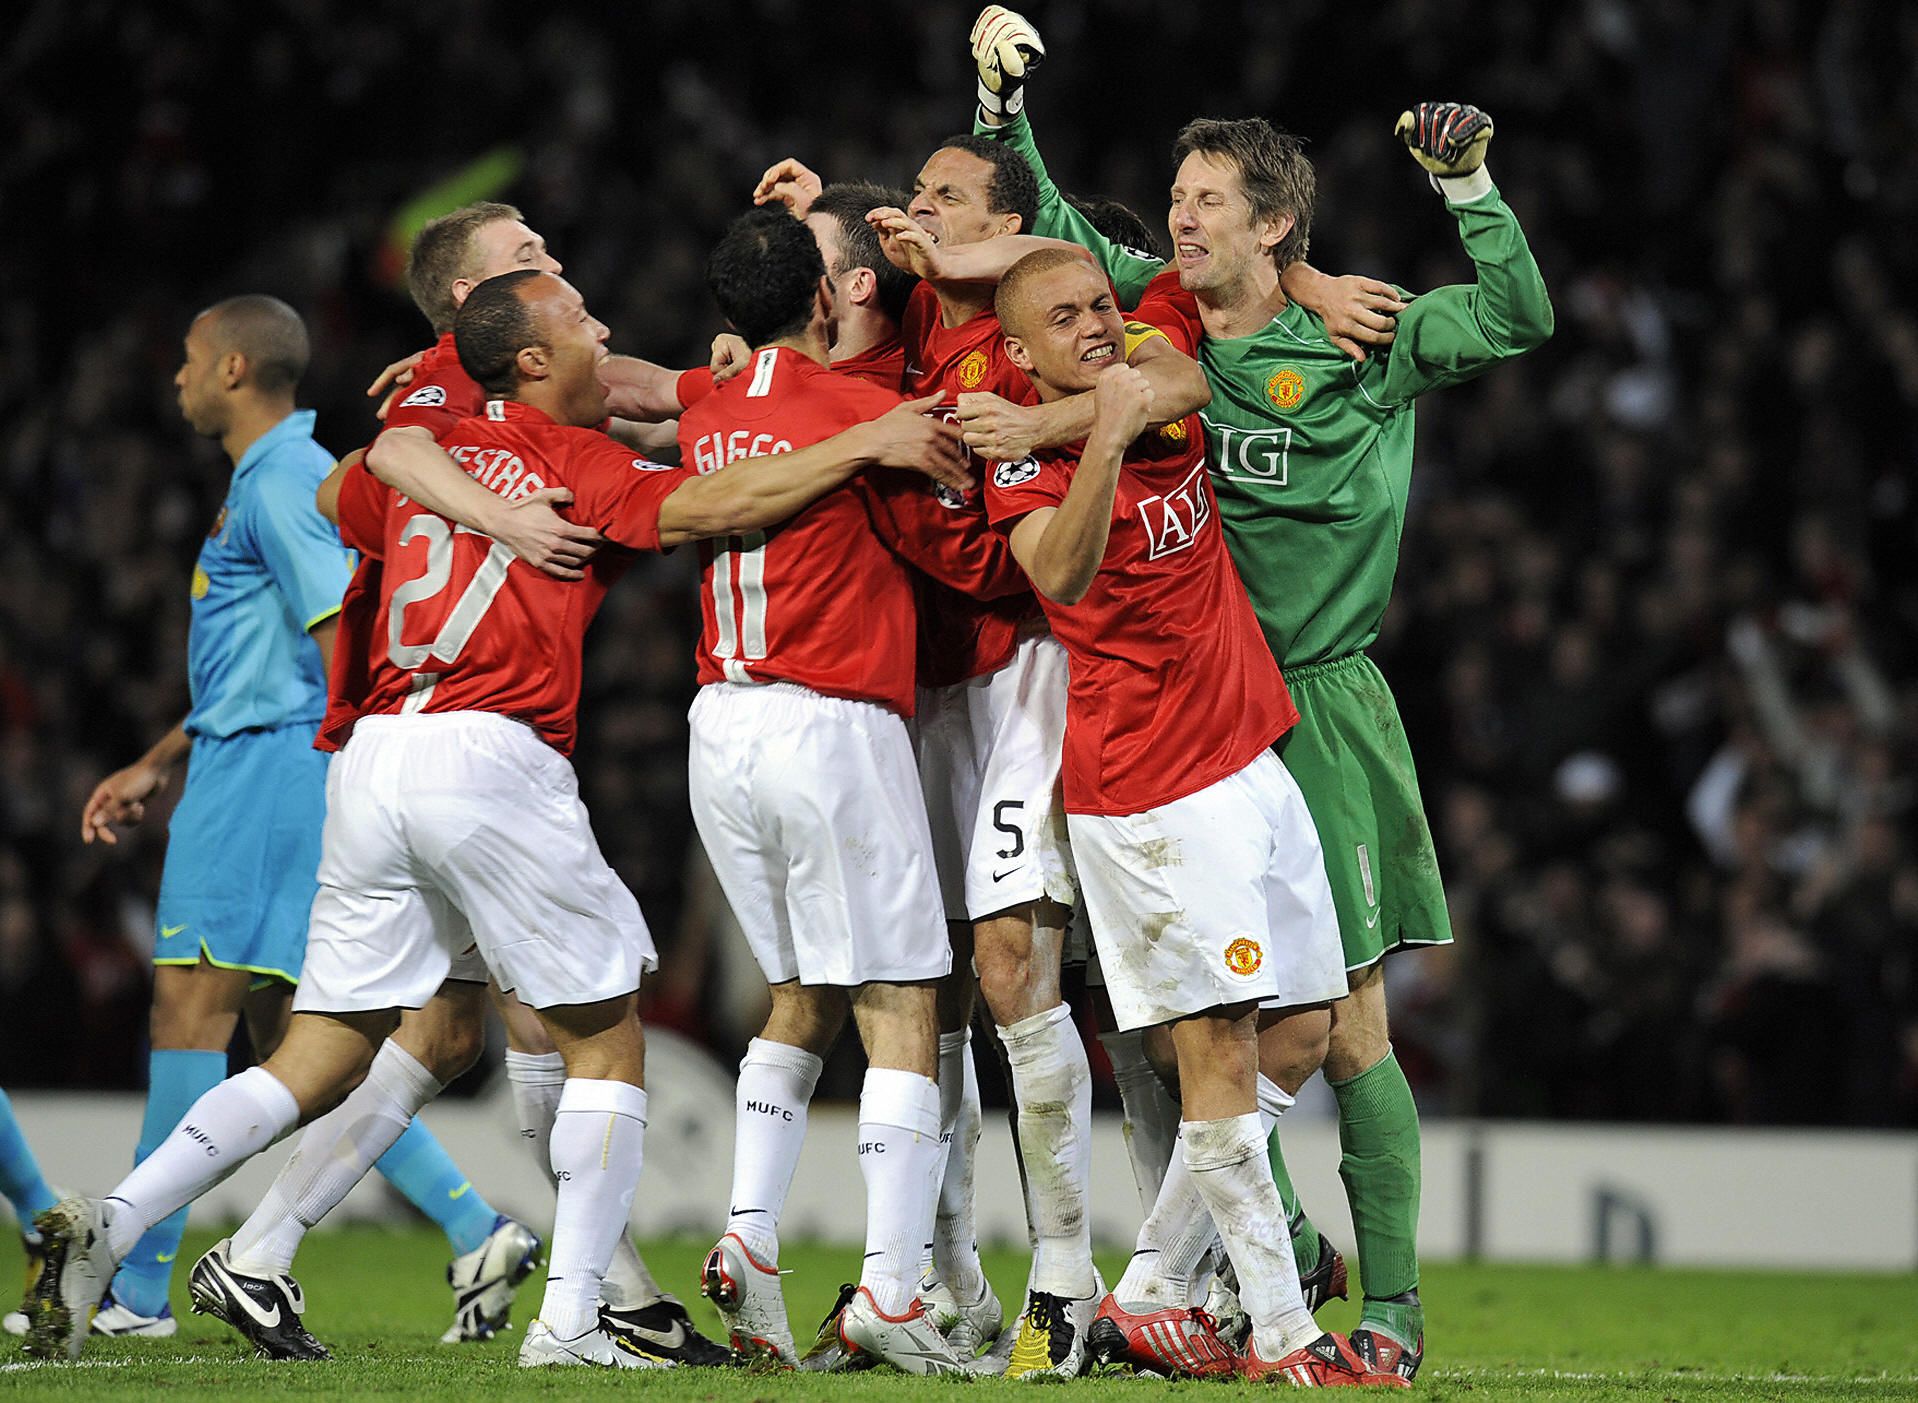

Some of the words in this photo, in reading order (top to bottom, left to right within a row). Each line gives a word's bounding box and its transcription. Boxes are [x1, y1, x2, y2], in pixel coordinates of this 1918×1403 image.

[448, 445, 545, 501] ESTRE
[1217, 427, 1280, 477] IG
[388, 514, 517, 669] 27
[712, 529, 768, 660] 11
[992, 800, 1025, 859] 5
[746, 1100, 793, 1122] MUFC
[182, 1124, 219, 1157] MUFC
